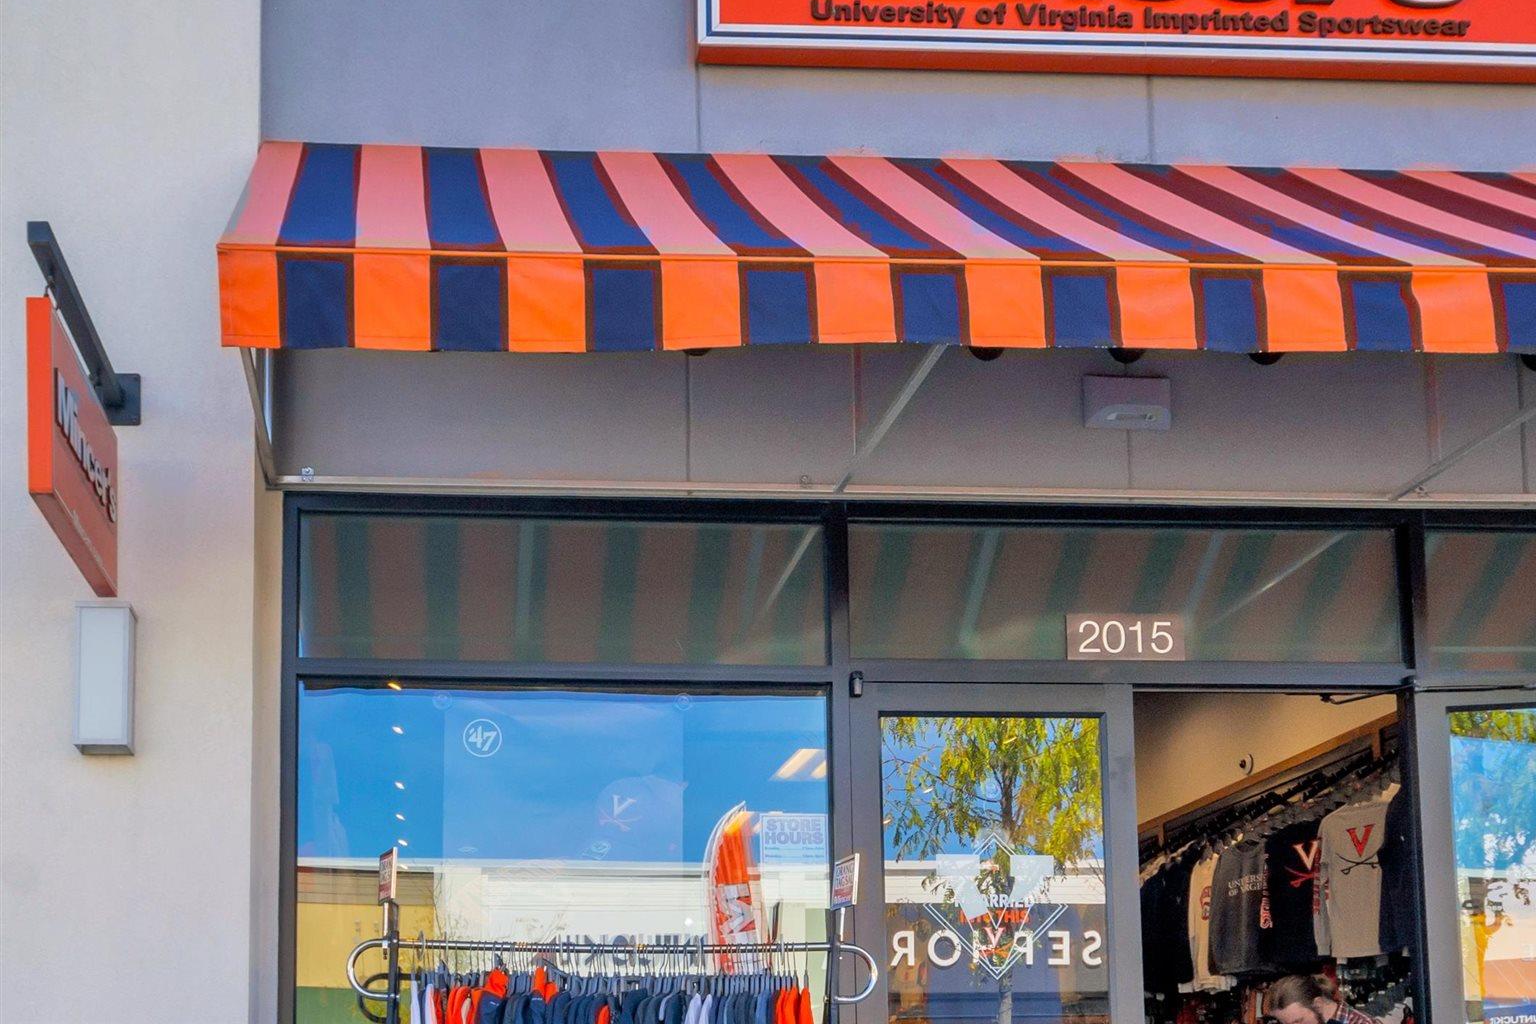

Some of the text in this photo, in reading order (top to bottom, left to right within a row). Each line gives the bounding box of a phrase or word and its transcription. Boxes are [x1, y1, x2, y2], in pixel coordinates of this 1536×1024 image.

[975, 2, 1007, 25] of
[1016, 2, 1135, 32] Virginia
[1143, 6, 1289, 34] Imprinted
[1298, 10, 1472, 38] Sportswear
[1078, 620, 1174, 654] 2015
[766, 819, 822, 832] STORE
[764, 832, 824, 845] HOURS
